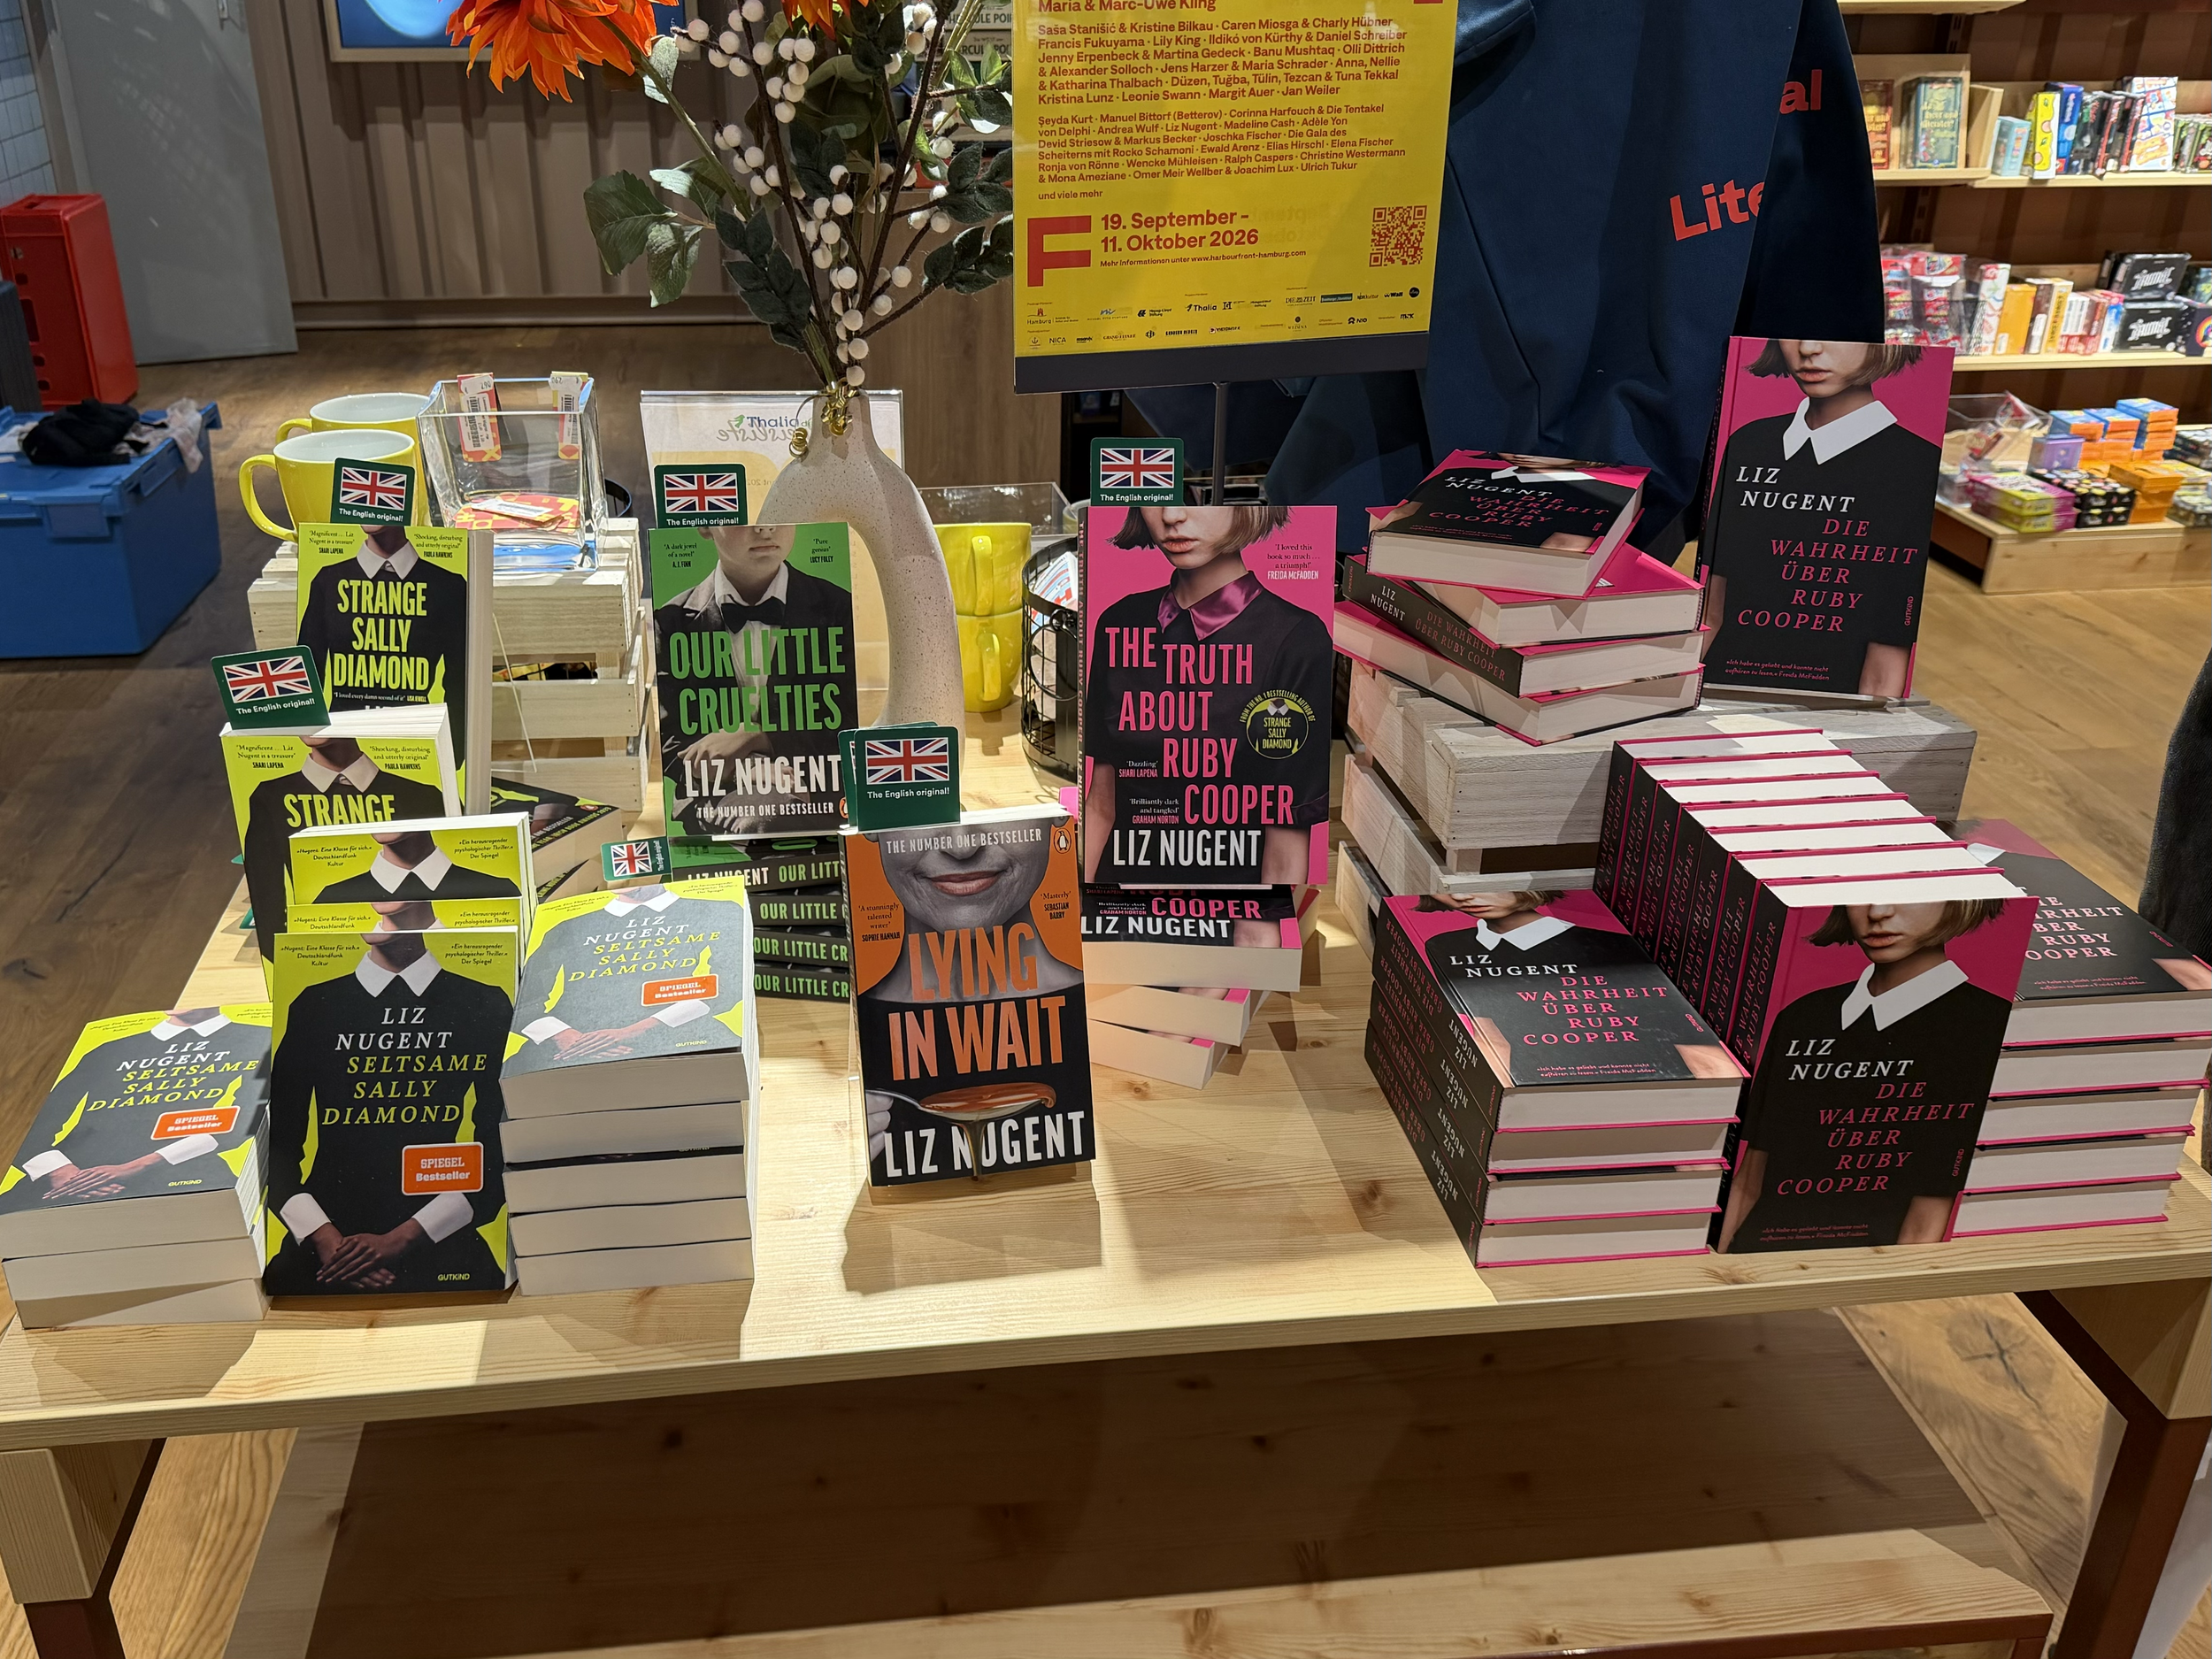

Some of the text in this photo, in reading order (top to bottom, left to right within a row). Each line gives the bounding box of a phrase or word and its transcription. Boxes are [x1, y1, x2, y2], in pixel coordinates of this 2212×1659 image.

[1039, 16, 1393, 35] Saša Stanišić & Kristine Bilkau Caren Miosga & Charly Hübner
[1059, 127, 1090, 137] Delphi
[1097, 125, 1133, 134] Andrea
[1135, 124, 1159, 133] Wulf
[1166, 122, 1179, 132] Liz
[1182, 122, 1217, 133] Nugent
[1225, 119, 1269, 129] Madeline
[1271, 119, 1294, 127] Cash
[1302, 117, 1328, 127] Adèle
[1331, 117, 1348, 126] Yon
[1039, 191, 1056, 200] und
[1079, 189, 1102, 198] mehr
[1102, 210, 1237, 232] 19. September
[1101, 229, 1258, 252] 11. Oktober 2026
[1191, 250, 1306, 262] www.harbourfront-hamburg.com
[1736, 466, 1781, 484] LIZ
[1740, 490, 1855, 513] NUGENT
[339, 508, 403, 522] The English original!
[1822, 518, 1870, 537] DIE
[1770, 539, 1918, 565] WAHRHEIT
[1268, 571, 1287, 580] FREIDA
[1780, 562, 1851, 585] ÜBER
[337, 579, 427, 617] STRANGE
[1381, 585, 1396, 601] LIZ
[1791, 588, 1863, 609] RUBY
[1370, 593, 1406, 621] NUGENT
[1737, 609, 1844, 633] COOPER
[351, 618, 411, 653] SALLY
[1427, 611, 1498, 658] DIE WAHRHEIT
[669, 626, 846, 680] OUR LITTLE
[1105, 627, 1157, 668] THE
[1416, 618, 1506, 681] ÜBER RUBY COOPER
[334, 654, 429, 691] DIAMOND
[1163, 644, 1253, 685] TRUTH
[679, 683, 842, 735] CRUELTIES
[1118, 691, 1213, 732] ABOUT
[1263, 718, 1291, 727] STRANGE
[1268, 728, 1286, 738] SALLY
[1262, 739, 1292, 749] DIAMOND
[1164, 738, 1238, 779] RUBY
[684, 756, 841, 797] LIZ NUGENT
[1136, 769, 1158, 778] LAPENA
[885, 789, 914, 798] English
[917, 787, 949, 796] original!
[284, 795, 395, 828] STRANGE
[697, 802, 833, 818] THE NUMBER ONE BESTSELLER
[1185, 784, 1294, 826] COOPER
[887, 828, 1042, 854] THE NUMBER ONE BESTSELLER
[1114, 830, 1261, 867] LIZ NUGENT
[760, 903, 837, 919] OUR LITTLE
[1044, 902, 1069, 911] SEBASTIAN
[1152, 897, 1262, 918] COOPER
[626, 917, 667, 929] LIZ
[1081, 916, 1230, 938] LIZ NUGENT
[583, 924, 689, 947] NUGENT
[593, 932, 722, 955] SELTSAME
[862, 932, 901, 942] SOPHIE HANNAH
[2040, 933, 2111, 945] RUBY
[598, 949, 675, 966] SALLY
[909, 922, 1038, 1002] LYING
[1449, 954, 1492, 965] LIZ
[2025, 947, 2118, 961] OOPER
[568, 957, 697, 982] DIAMOND
[1466, 964, 1578, 978] NUGENT
[1560, 975, 1609, 987] DIE
[1516, 987, 1668, 1002] WAHRHEIT
[381, 1007, 426, 1025] LIZ
[1542, 1001, 1617, 1015] ÜBER
[1568, 1016, 1640, 1029] RUBY
[334, 1031, 453, 1051] NUGENT
[888, 996, 1065, 1081] IN WAIT
[1523, 1030, 1640, 1045] COOPER
[1786, 1039, 1837, 1056] LIZ
[346, 1053, 488, 1075] SELTSAME
[1788, 1060, 1915, 1081] NUGENT
[353, 1080, 438, 1100] SALLY
[1877, 1081, 1927, 1100] DIE
[321, 1105, 462, 1125] DIAMOND
[1818, 1102, 1975, 1125] WAHRHEIT
[884, 1110, 1085, 1178] LIZ NUGENT
[1827, 1127, 1901, 1148] ÜBER
[420, 1156, 465, 1169] SPIEGEL
[1835, 1151, 1914, 1171] RUBY
[416, 1170, 471, 1182] Bestseller
[1776, 1174, 1890, 1195] COOPER
